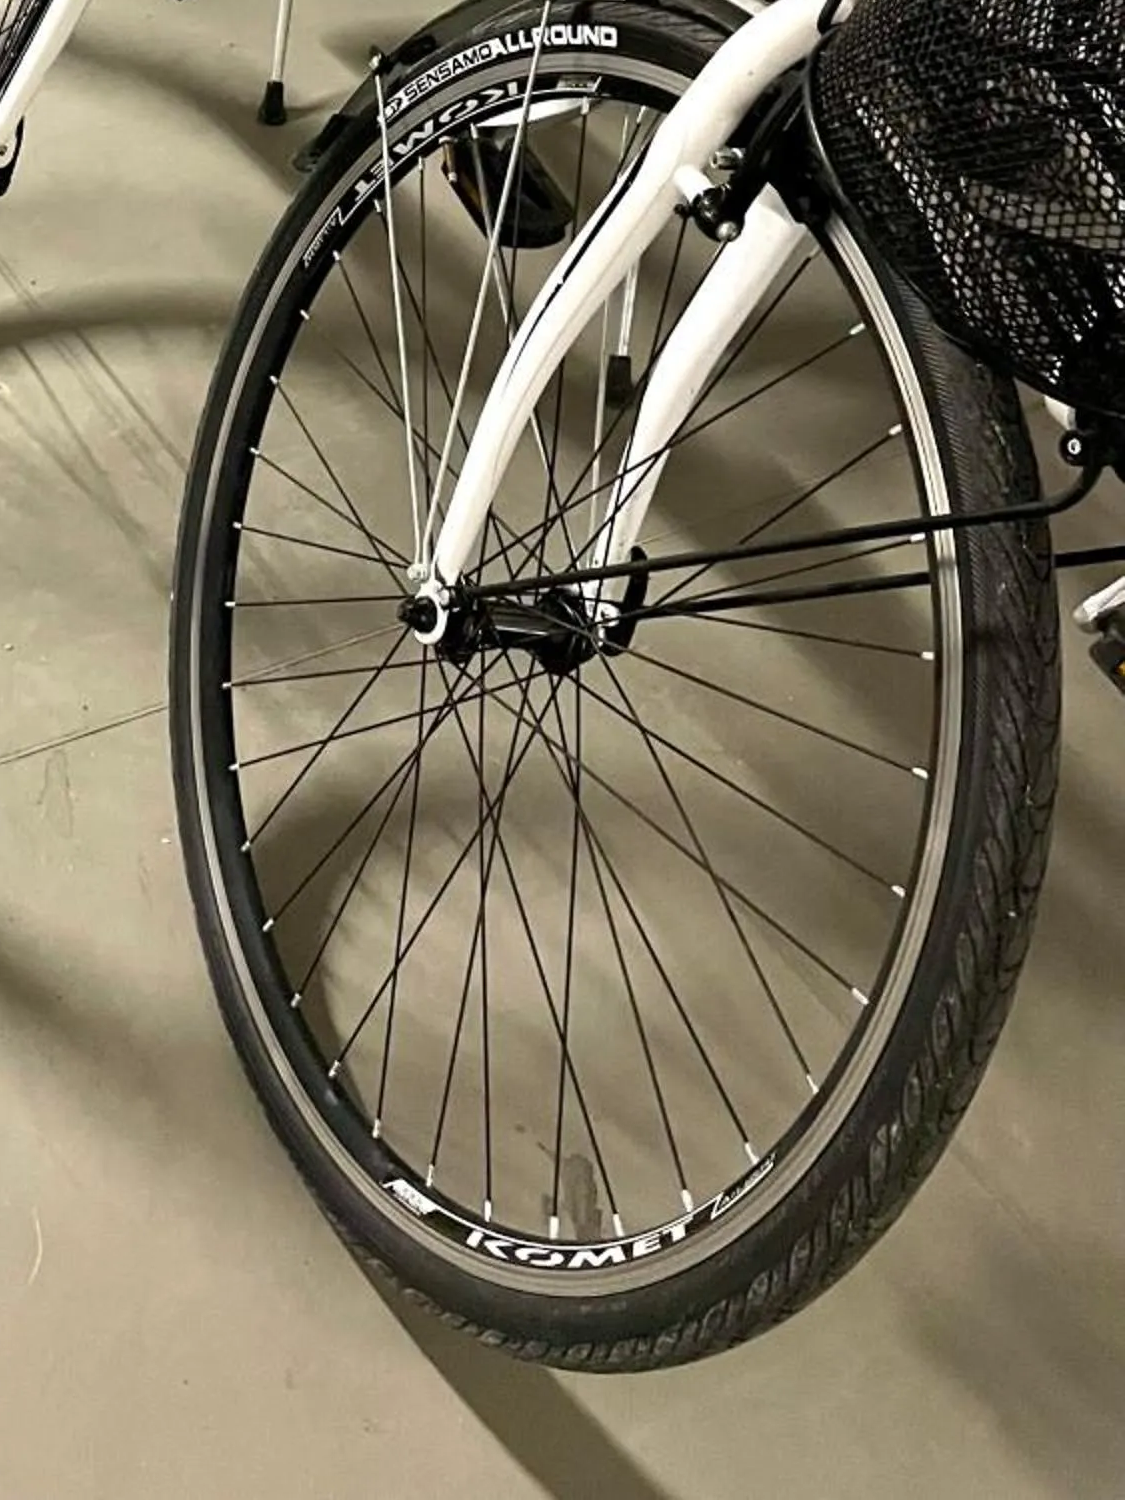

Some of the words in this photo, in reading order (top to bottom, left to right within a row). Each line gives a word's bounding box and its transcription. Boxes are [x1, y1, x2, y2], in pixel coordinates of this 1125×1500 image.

[403, 42, 494, 101] SENSAMO
[490, 23, 618, 57] ALLROUND
[466, 1214, 694, 1269] KOMET
